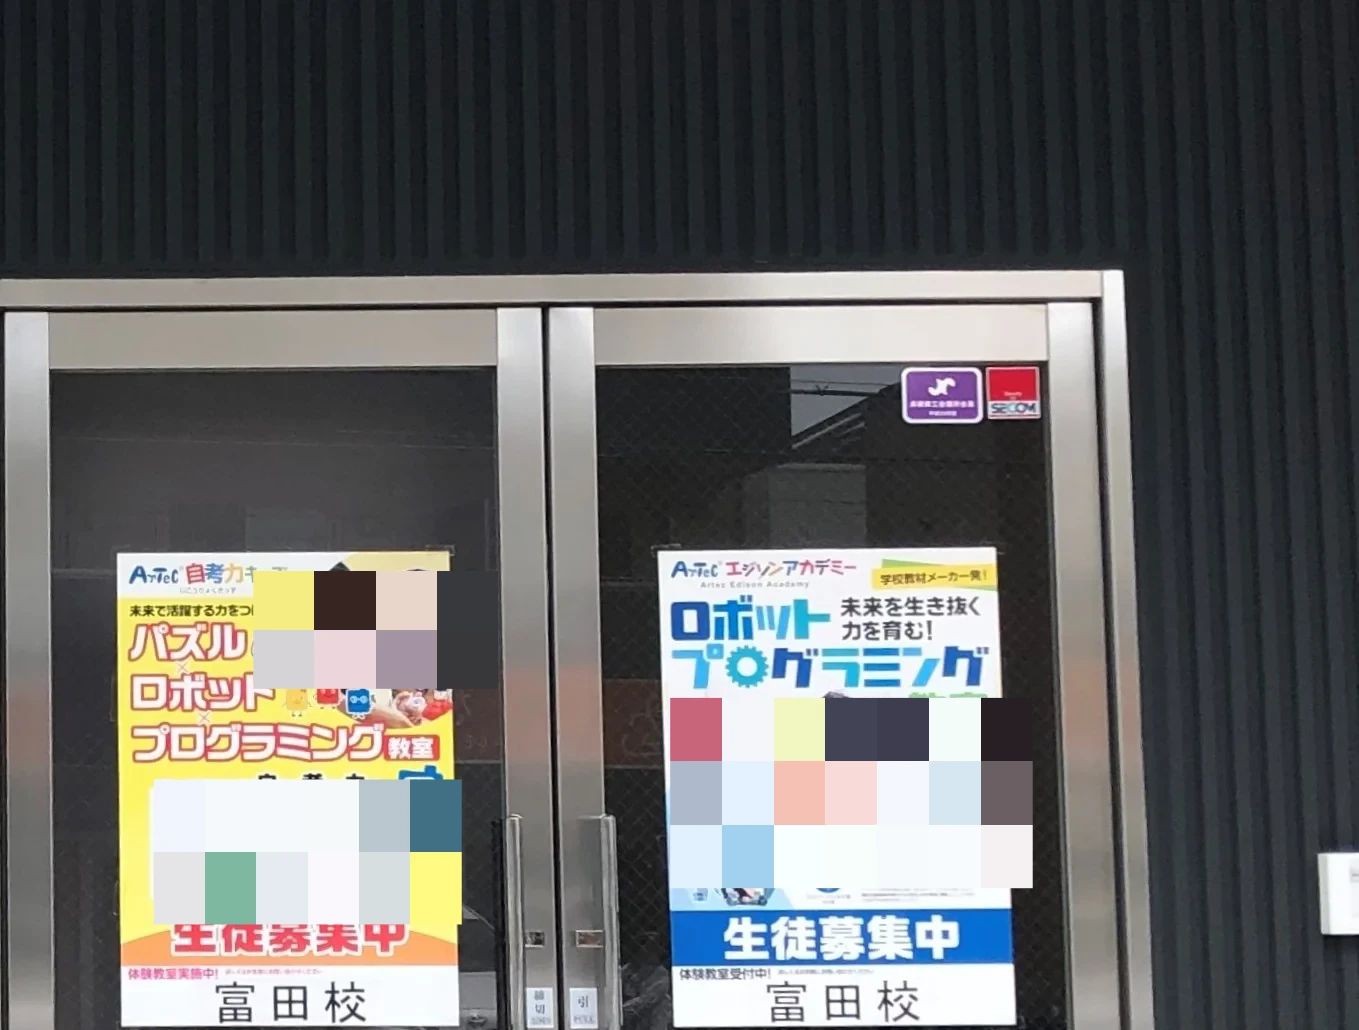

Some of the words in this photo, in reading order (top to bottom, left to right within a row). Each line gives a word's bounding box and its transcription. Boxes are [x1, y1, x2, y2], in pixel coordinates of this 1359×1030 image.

[726, 559, 857, 577] エジソンアカデミー
[730, 581, 763, 589] Edison
[766, 581, 809, 590] Academy
[129, 604, 254, 617] 未来で活躍する力をつ
[670, 594, 831, 641] ロボット
[840, 597, 981, 617] 未来を生き抜く
[128, 621, 247, 661] パズル
[841, 620, 933, 641] 力を育む!
[671, 643, 990, 690] プログラミング
[130, 672, 276, 712] ロボット
[131, 722, 386, 763] プログラミング
[387, 736, 436, 761] 教室
[723, 913, 961, 961] 生徒募集中
[215, 981, 367, 1024] 富田校
[766, 981, 920, 1023] 富田校
